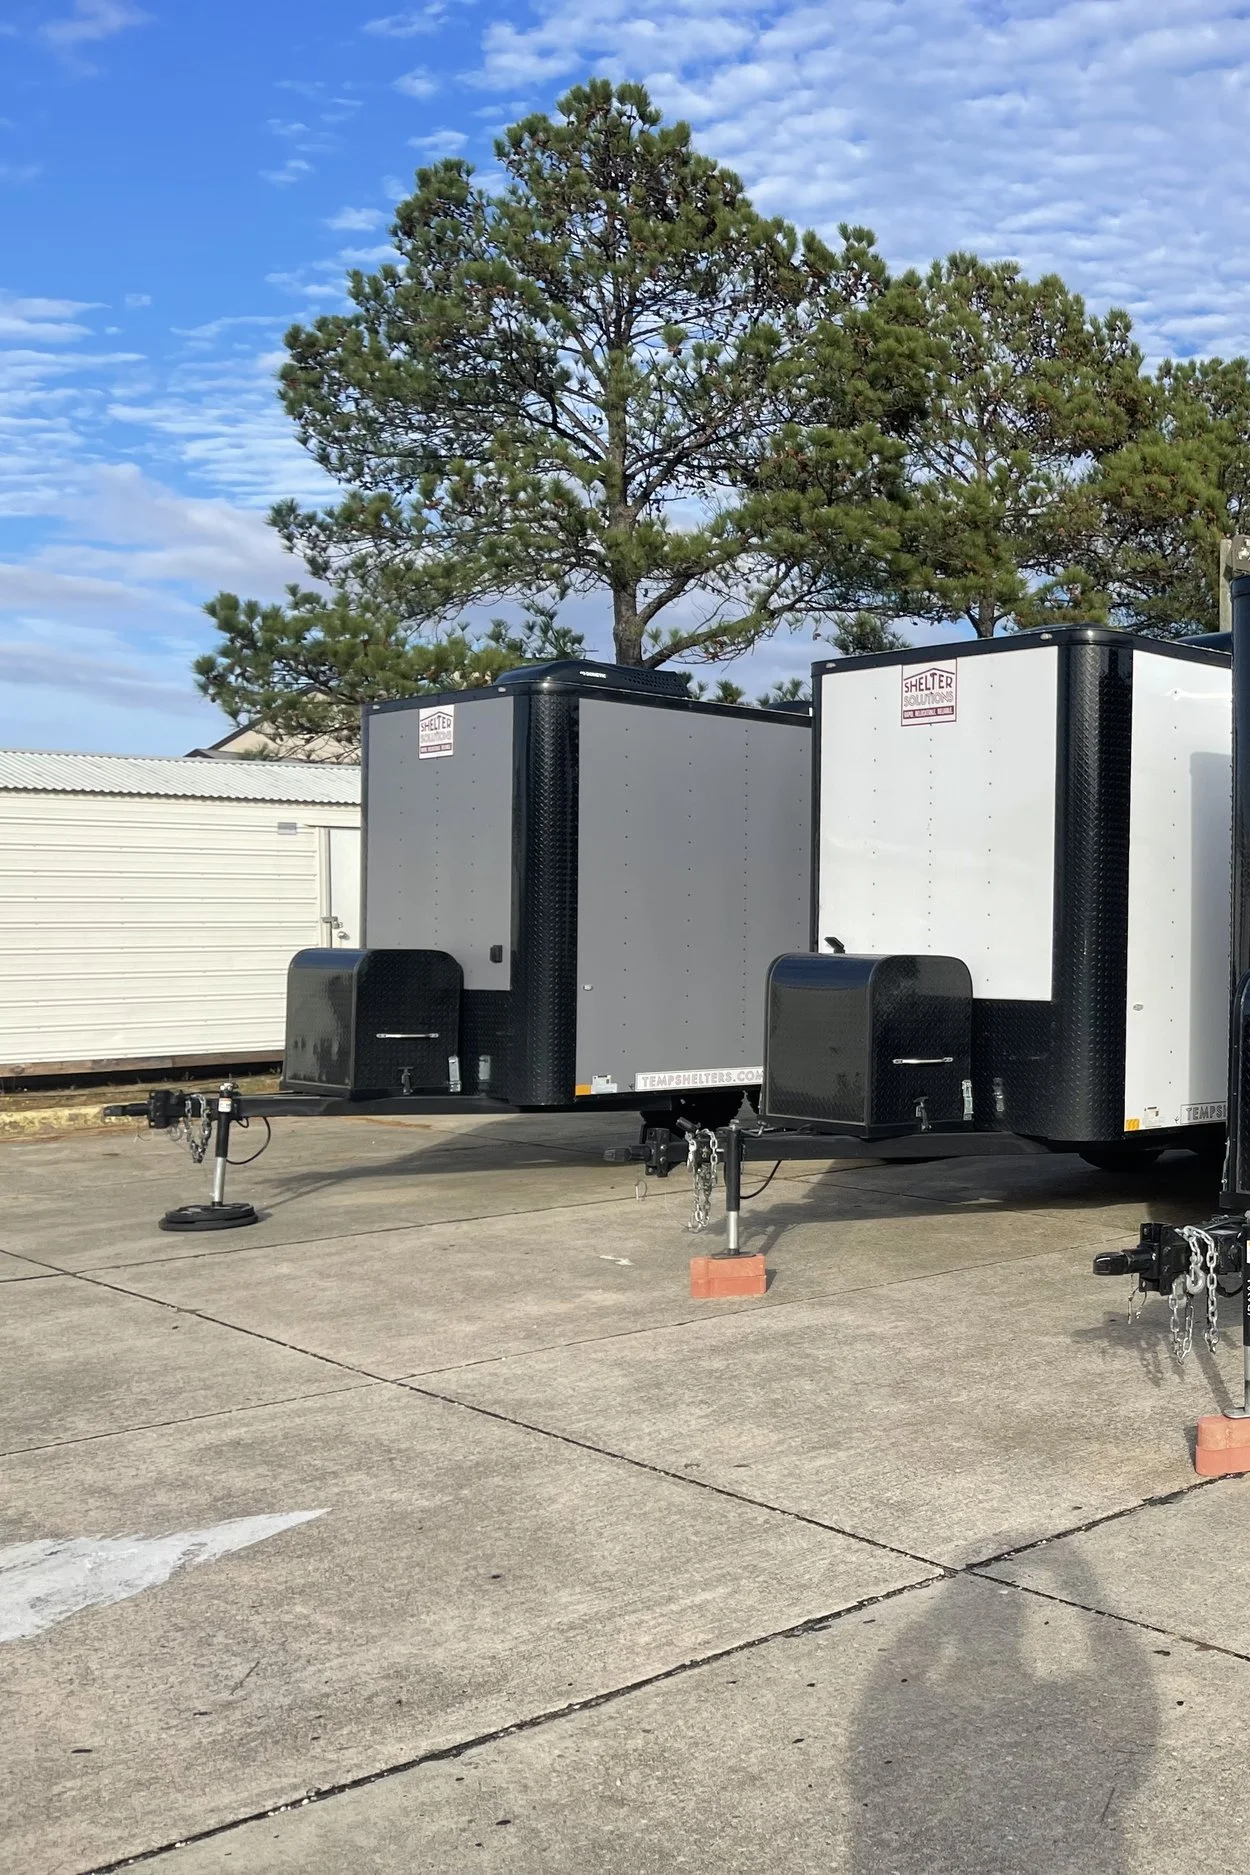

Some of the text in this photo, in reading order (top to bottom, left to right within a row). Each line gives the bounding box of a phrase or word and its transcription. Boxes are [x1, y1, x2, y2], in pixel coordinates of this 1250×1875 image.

[904, 672, 953, 693] SHELTER
[903, 691, 954, 707] SOLUTIONS
[421, 714, 452, 732] SHELTER
